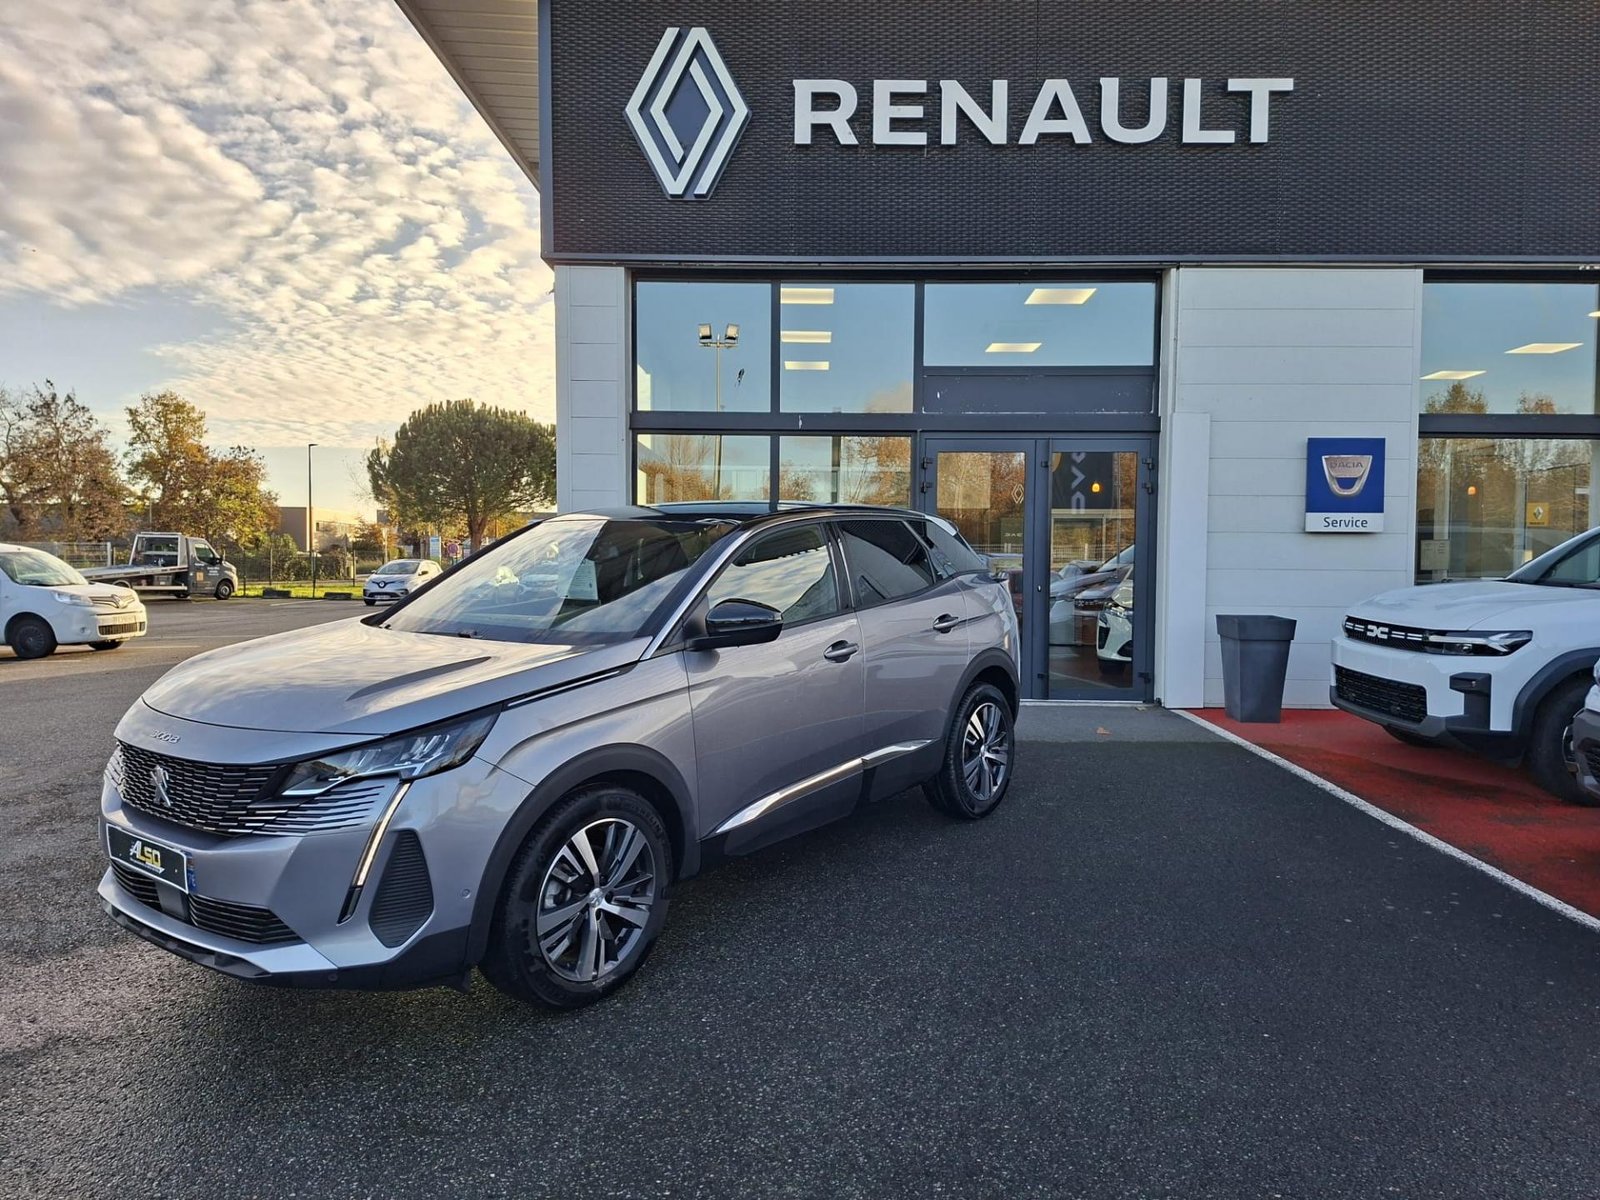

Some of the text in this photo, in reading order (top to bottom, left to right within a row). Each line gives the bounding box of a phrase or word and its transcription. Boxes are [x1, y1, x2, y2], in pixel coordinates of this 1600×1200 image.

[792, 77, 1295, 146] RENAULT
[1329, 461, 1364, 469] DACIA
[1323, 516, 1369, 528] Service
